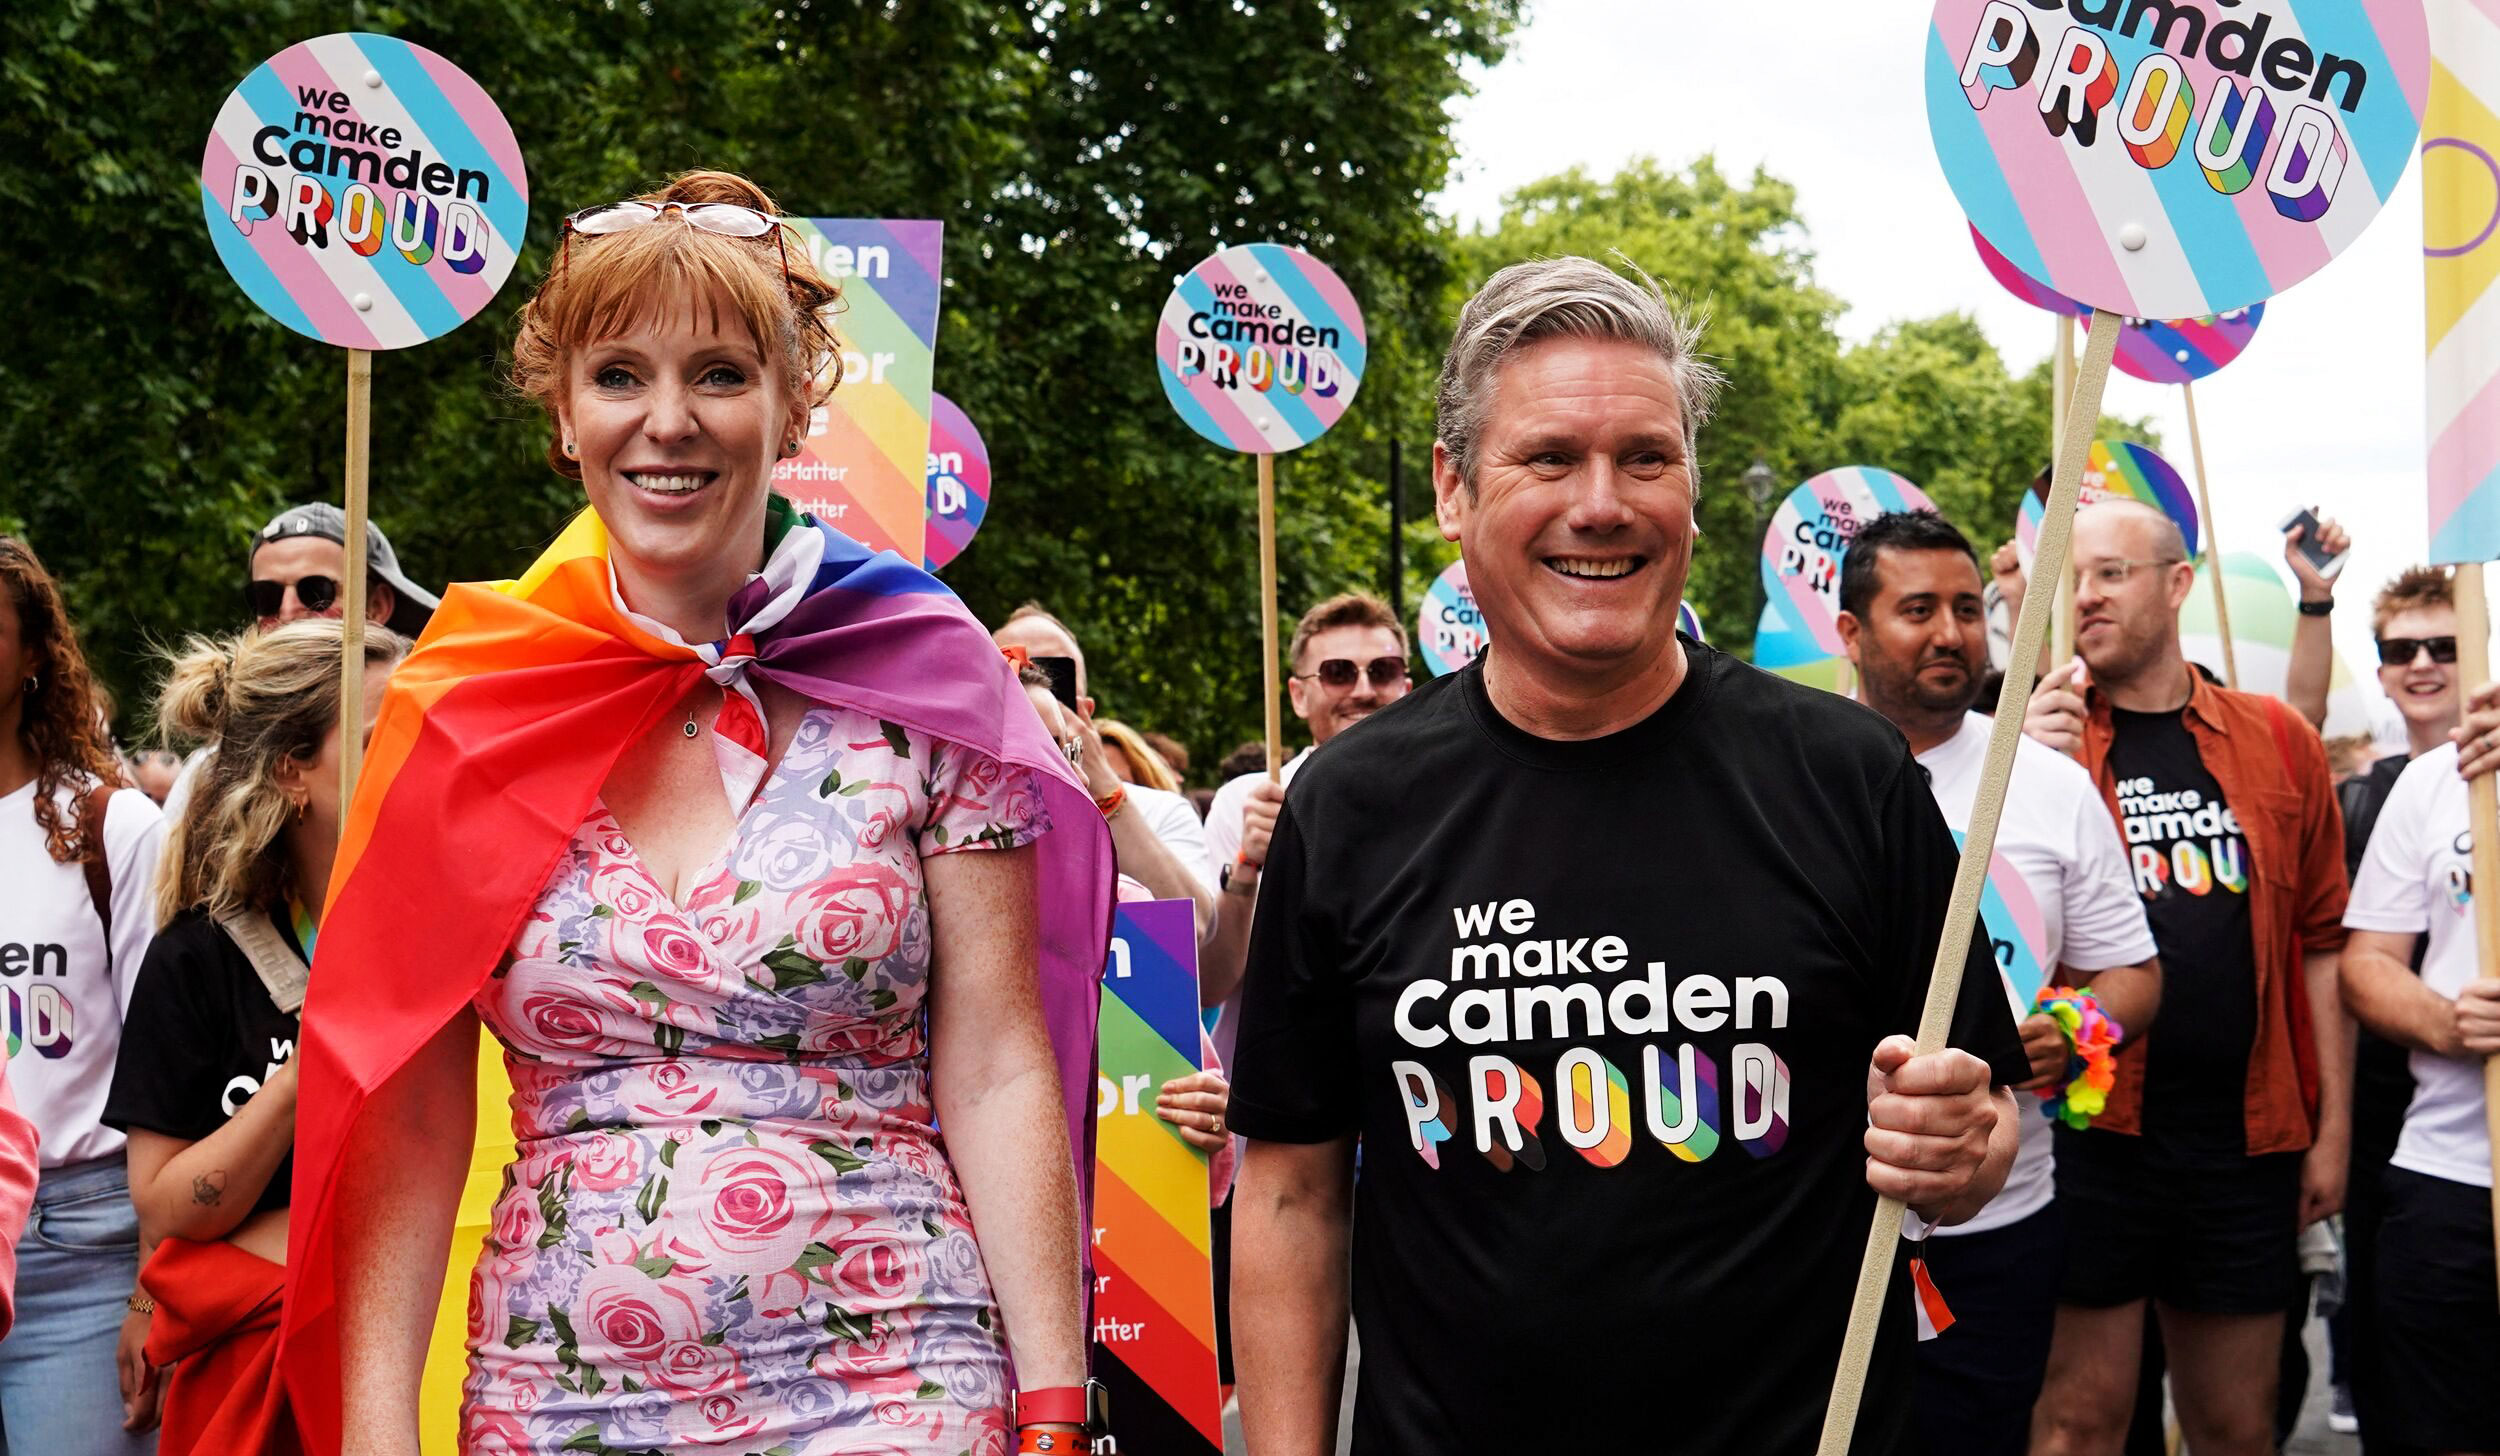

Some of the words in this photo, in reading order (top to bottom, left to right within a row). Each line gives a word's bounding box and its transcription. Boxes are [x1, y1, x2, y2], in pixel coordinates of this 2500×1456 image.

[2027, 0, 2367, 114] amden
[298, 85, 350, 113] we
[1960, 0, 2348, 222] PROUD
[294, 111, 403, 149] make
[253, 125, 489, 203] Camden
[230, 164, 489, 275] PROUD
[1213, 300, 1281, 319] make
[1214, 283, 1248, 299] we
[1188, 312, 1339, 349] Camden
[1176, 340, 1341, 398] PROUD
[1823, 497, 1852, 515] we
[2115, 777, 2155, 797] we
[2119, 790, 2201, 815] make
[1453, 898, 1536, 939] we
[1451, 935, 1629, 981] make
[1394, 961, 1789, 1048] Camden
[1392, 1042, 1791, 1172] PROUD
